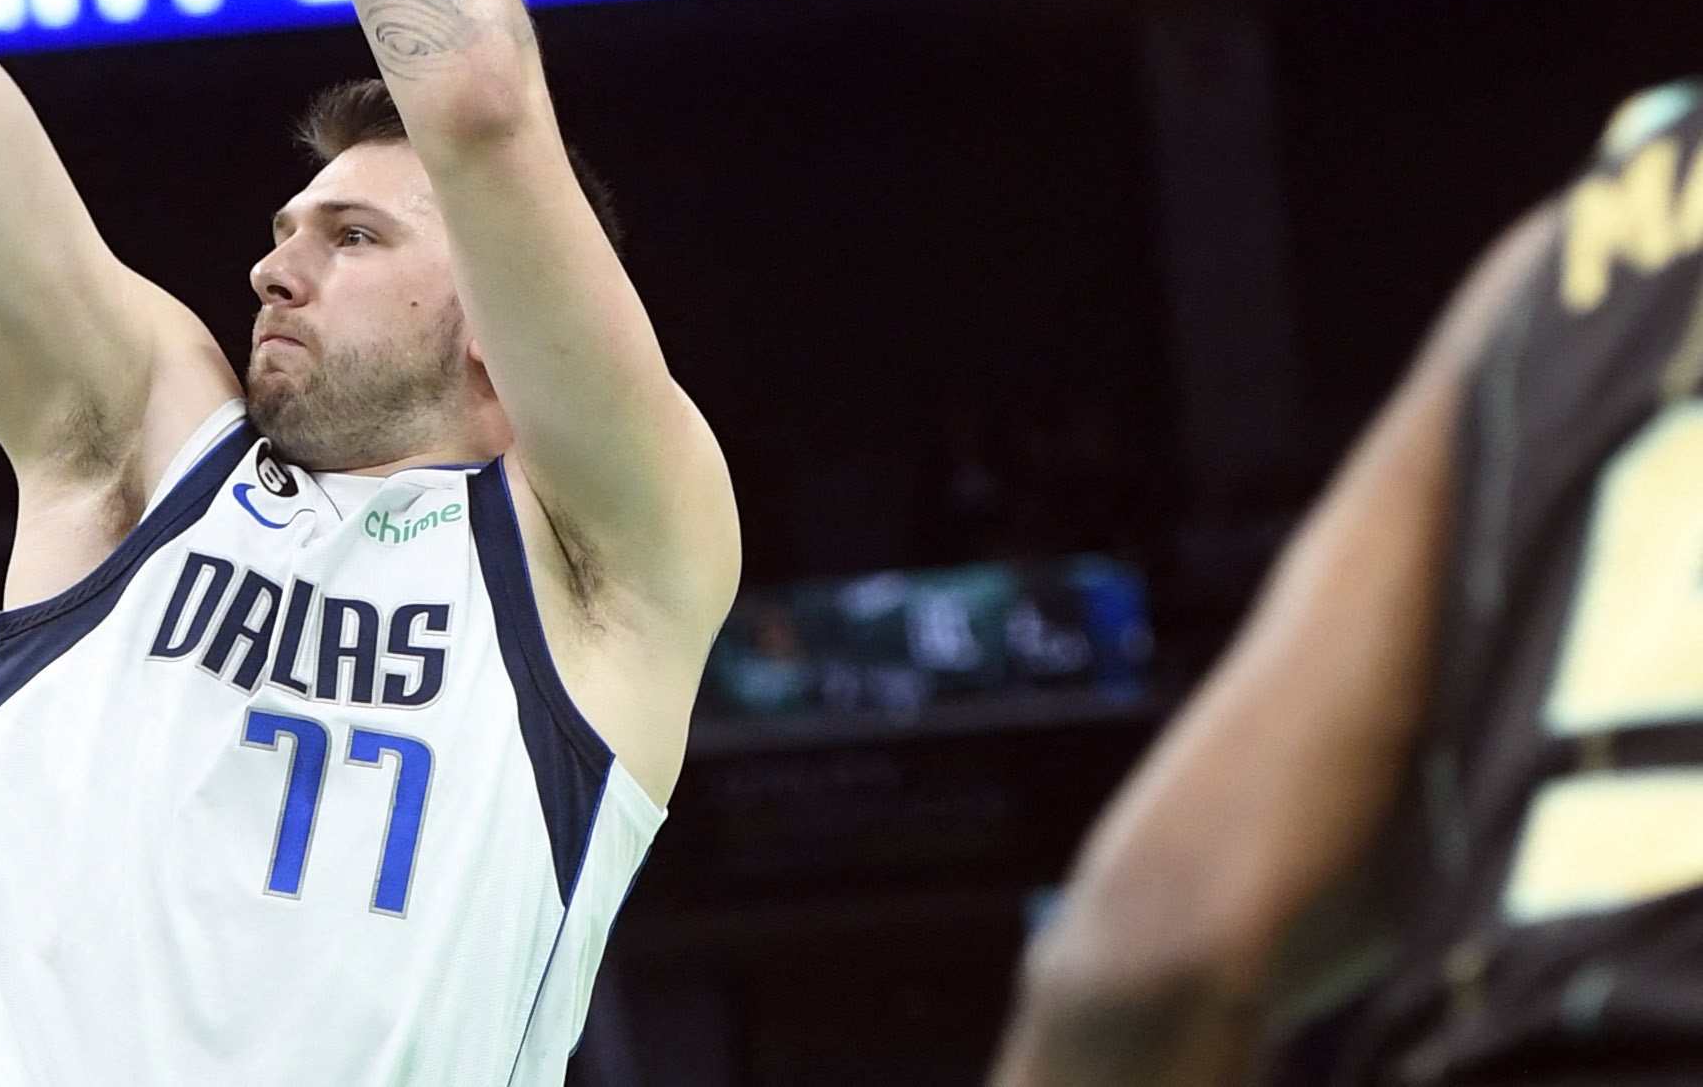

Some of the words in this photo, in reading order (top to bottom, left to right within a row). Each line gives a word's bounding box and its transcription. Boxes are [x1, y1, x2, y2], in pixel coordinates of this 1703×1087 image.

[364, 503, 463, 544] Chime
[144, 546, 455, 711] DALAS
[239, 706, 436, 920] 77
